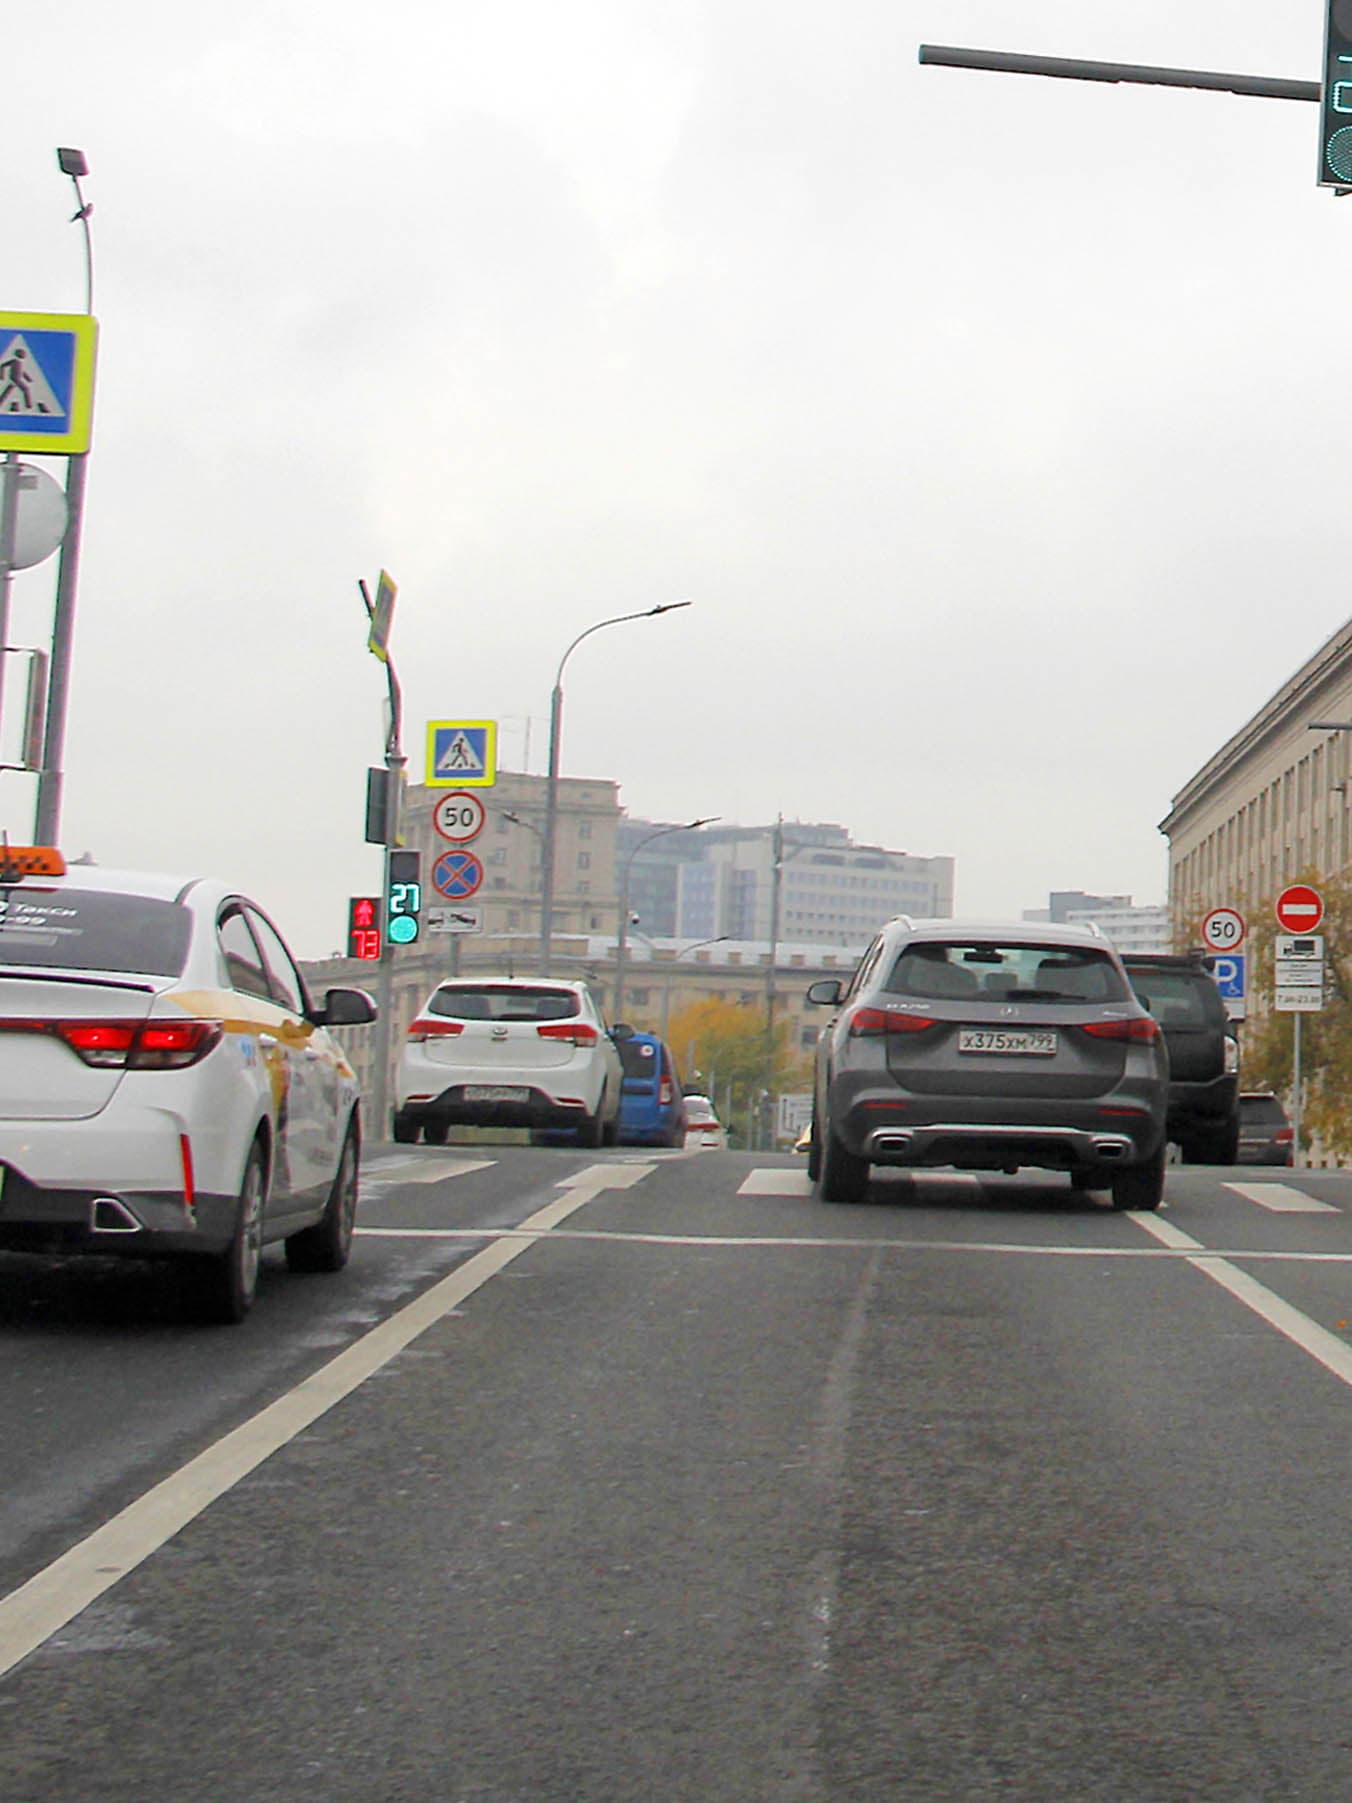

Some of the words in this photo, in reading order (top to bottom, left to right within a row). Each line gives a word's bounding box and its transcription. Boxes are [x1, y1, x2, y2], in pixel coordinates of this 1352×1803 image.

[444, 807, 475, 828] 50
[390, 883, 420, 914] 27
[1211, 921, 1236, 939] 50
[352, 930, 381, 960] 73
